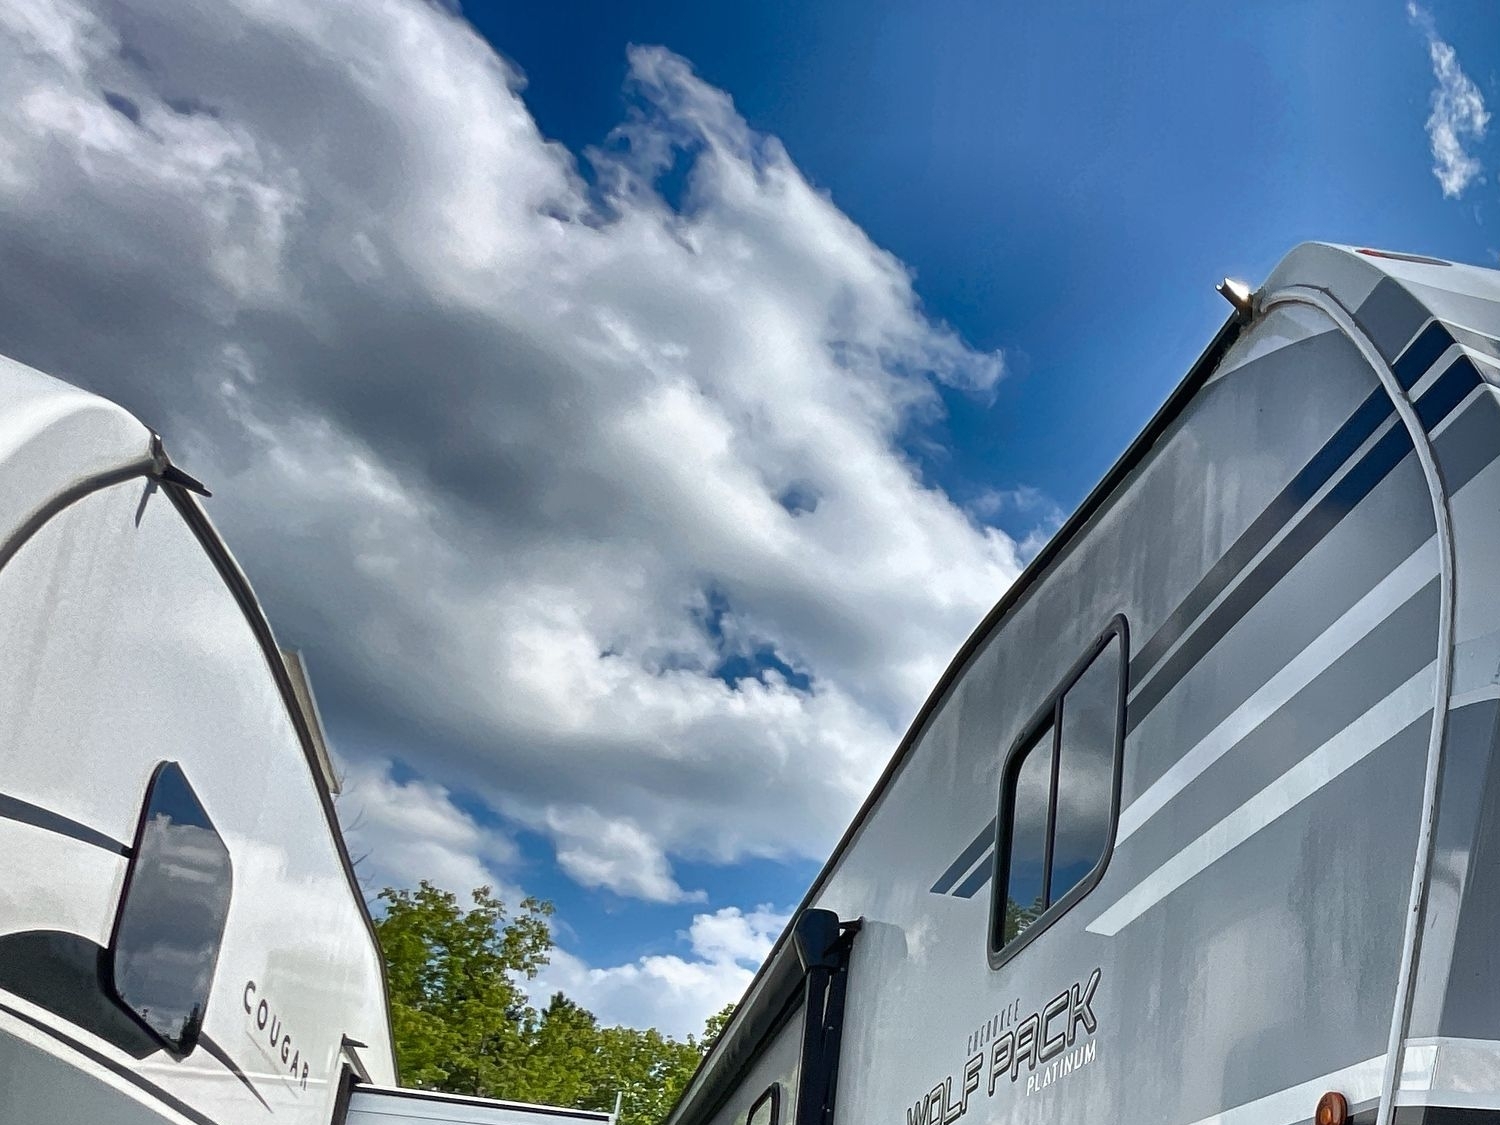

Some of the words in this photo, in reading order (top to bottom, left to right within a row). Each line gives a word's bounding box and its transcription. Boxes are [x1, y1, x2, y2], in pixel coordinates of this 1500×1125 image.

[243, 980, 309, 1091] COUGAR
[988, 967, 1101, 1097] PACK
[1026, 1039, 1096, 1096] PLATINUM
